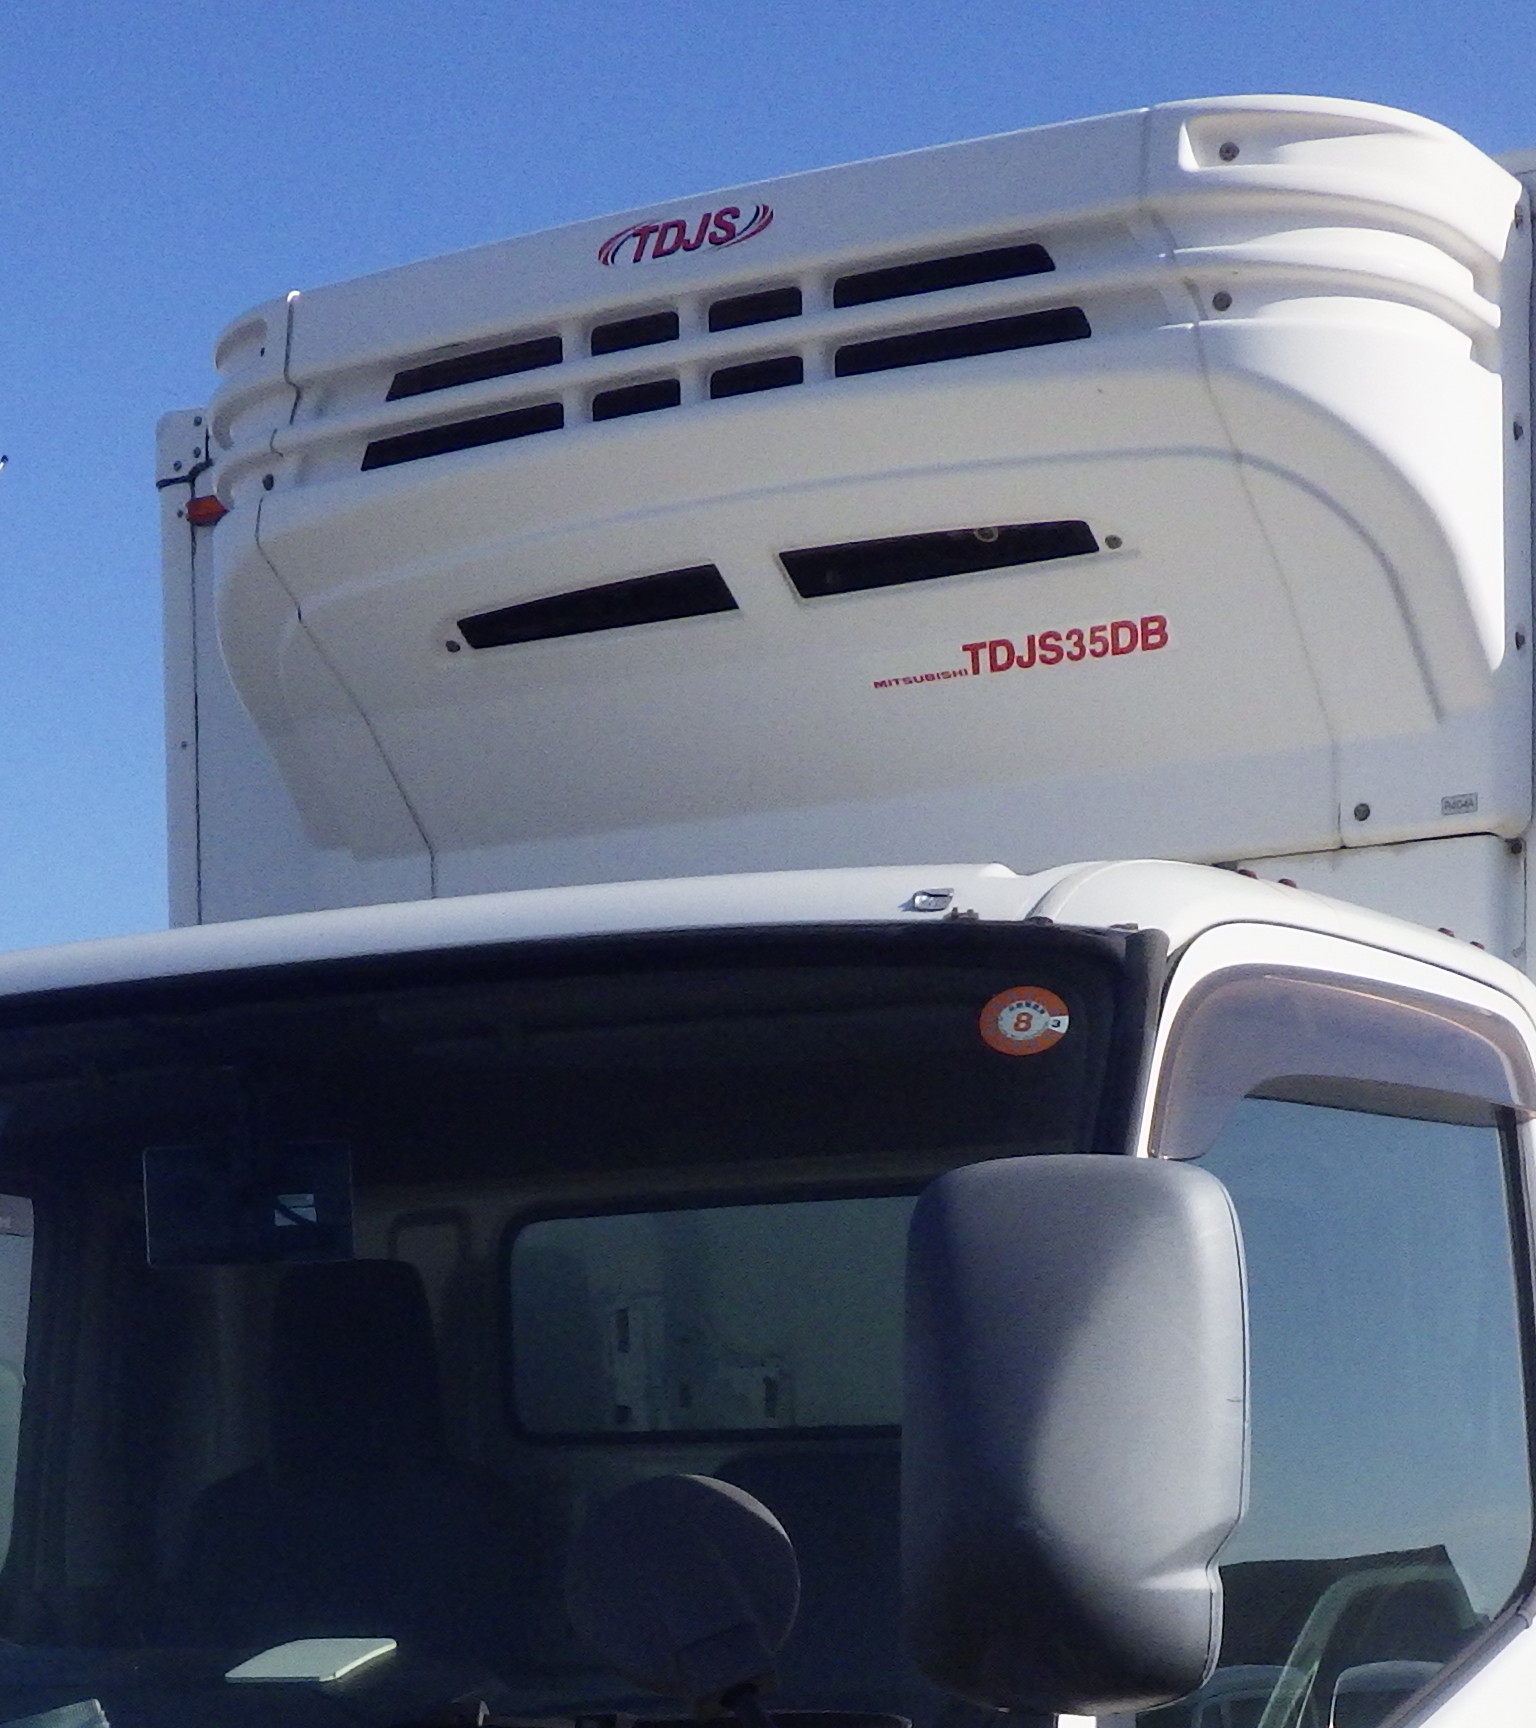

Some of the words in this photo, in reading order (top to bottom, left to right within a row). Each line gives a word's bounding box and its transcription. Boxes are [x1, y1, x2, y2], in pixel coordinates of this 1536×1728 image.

[631, 206, 741, 263] TDJS
[873, 669, 968, 689] MITSUBISHI
[962, 615, 1169, 675] TDJS35DB
[1014, 1012, 1032, 1032] 8
